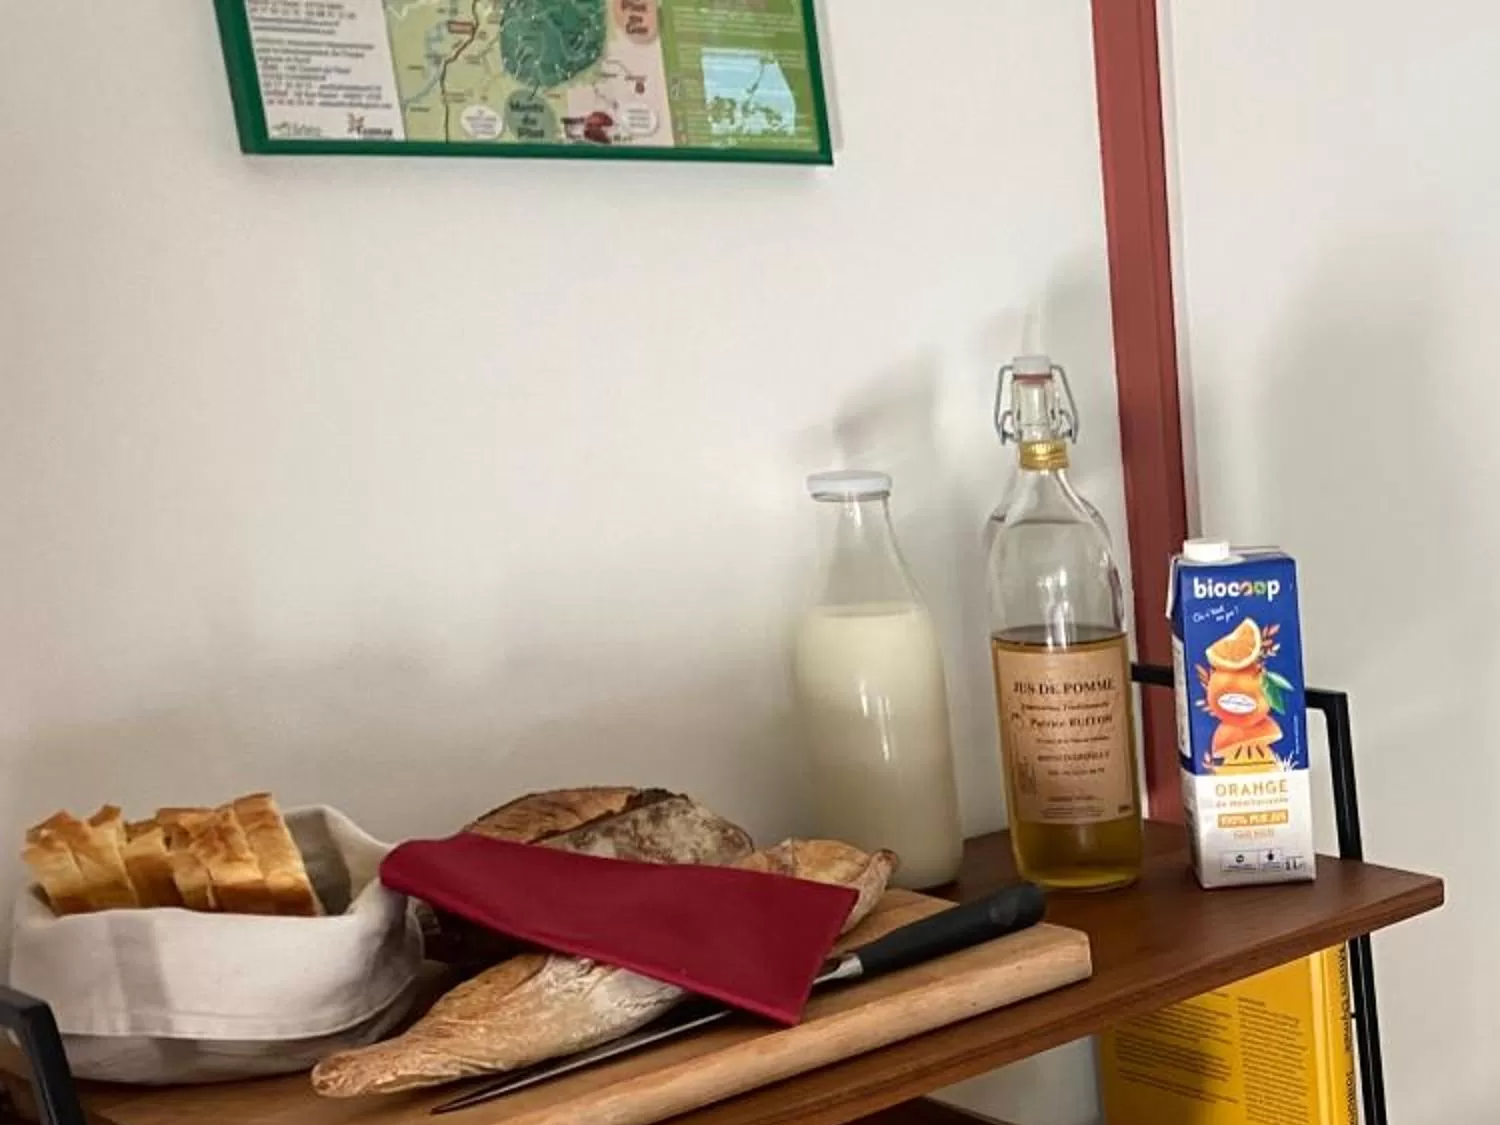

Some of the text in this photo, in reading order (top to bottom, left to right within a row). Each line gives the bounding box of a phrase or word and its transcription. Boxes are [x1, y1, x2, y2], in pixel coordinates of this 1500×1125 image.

[1193, 576, 1281, 603] biocoop
[1063, 678, 1117, 694] POMME
[1215, 779, 1289, 798] ORANGE
